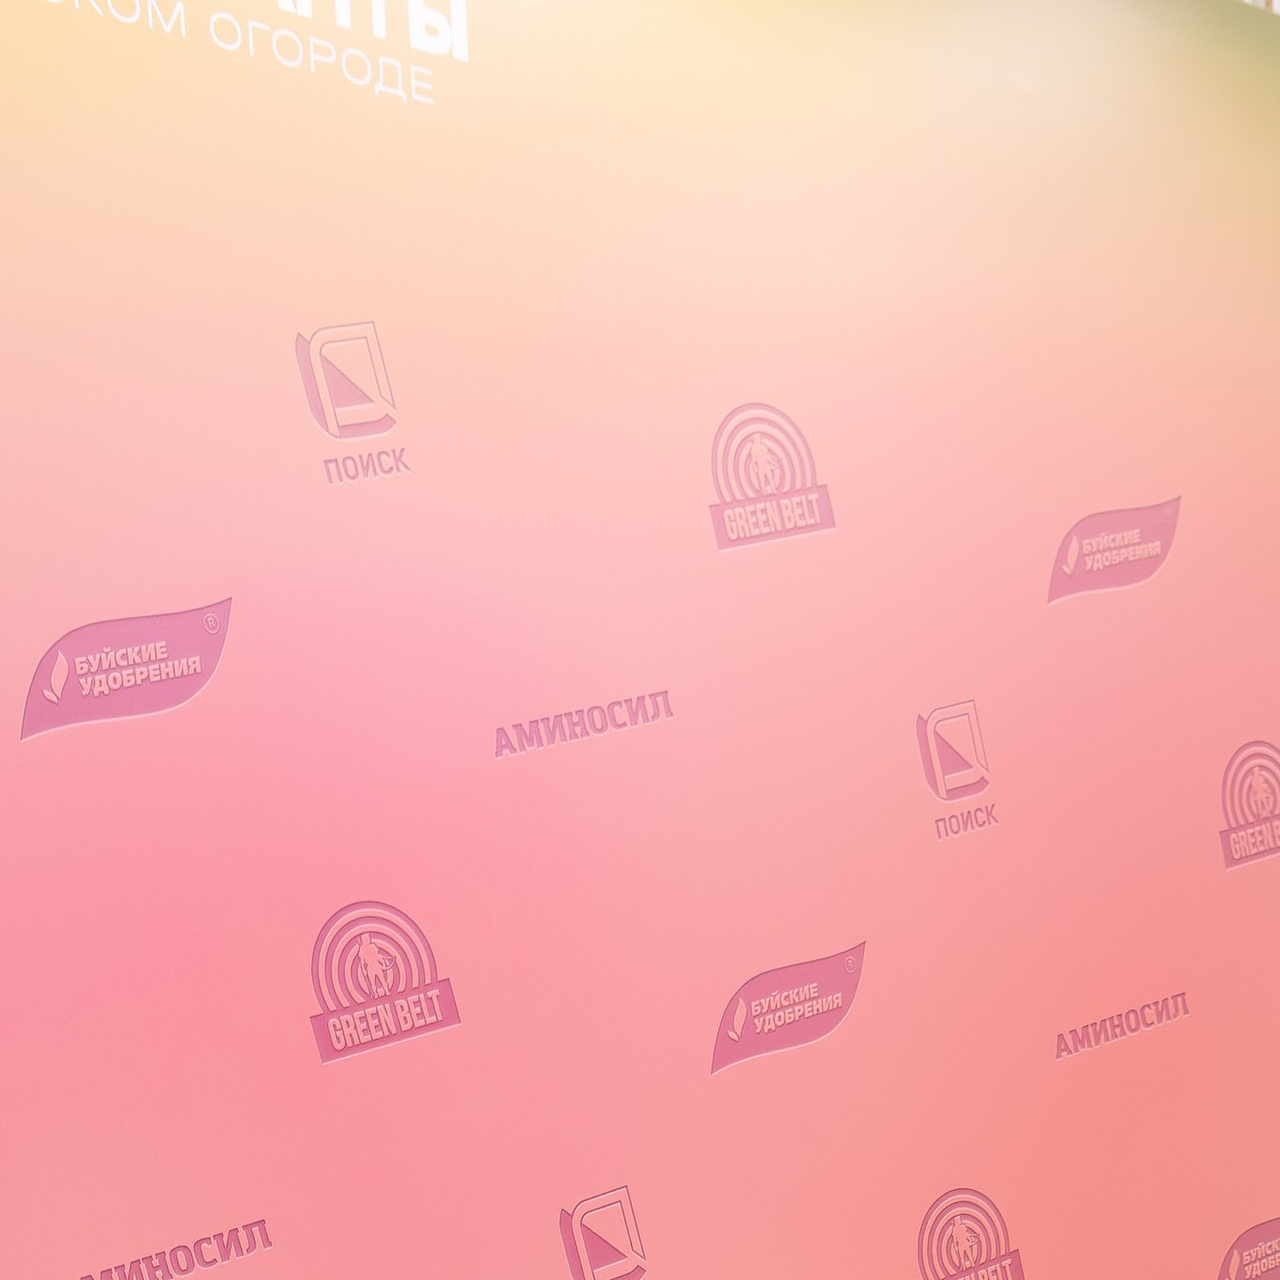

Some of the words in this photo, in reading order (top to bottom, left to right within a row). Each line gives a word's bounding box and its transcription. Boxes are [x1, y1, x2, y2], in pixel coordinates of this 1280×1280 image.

[209, 11, 434, 104] ОГОРОДЕ
[323, 448, 411, 484] ПОИСК
[723, 500, 782, 540] GREEN
[780, 493, 820, 530] BELT
[74, 641, 168, 675] БУЙСКИЕ
[79, 656, 202, 697] УДОБРЕНИЯ
[495, 690, 672, 758] АМИНОСИЛ
[935, 804, 999, 839] ПОИСК
[1230, 822, 1276, 860] GREEN
[750, 982, 819, 1017] БУЙСКИЕ
[753, 992, 843, 1034] УДОБРЕНИЯ
[328, 1003, 397, 1052] GREEN
[394, 989, 443, 1032] BELT
[1055, 992, 1190, 1059] АМИНОСИЛ
